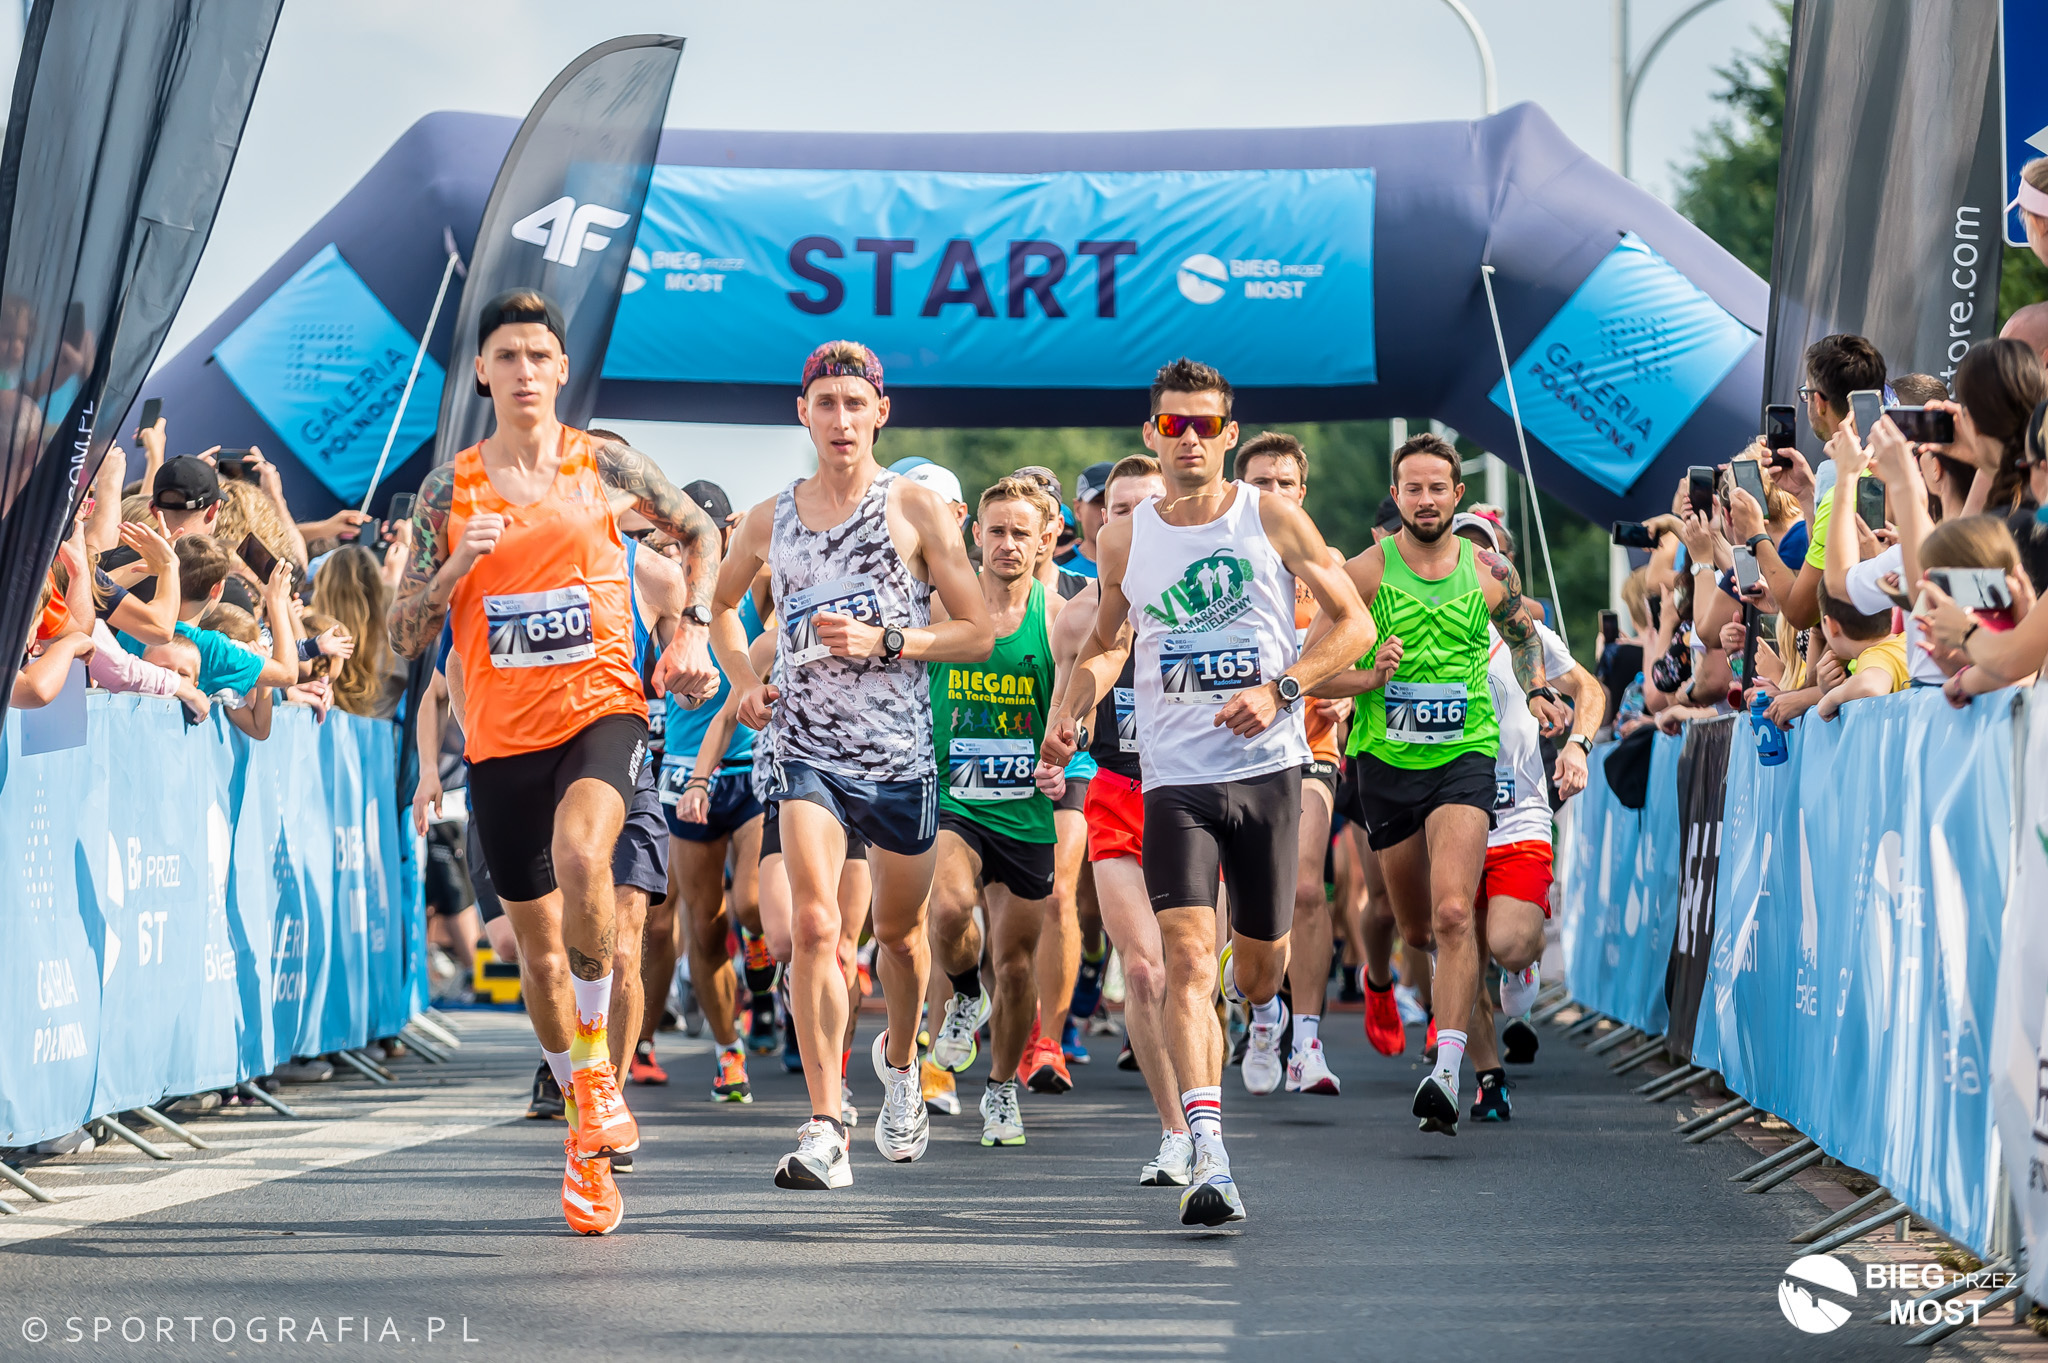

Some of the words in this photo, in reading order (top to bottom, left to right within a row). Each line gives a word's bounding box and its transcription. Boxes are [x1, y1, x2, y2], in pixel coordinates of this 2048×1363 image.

[511, 195, 631, 268] 4F
[651, 250, 702, 271] BIEG
[1229, 259, 1281, 278] BIEG
[664, 273, 726, 293] MOST
[787, 236, 1138, 319] START
[1244, 280, 1307, 299] MOST
[301, 347, 409, 446] GALERIA
[1545, 342, 1654, 443] GALERIA
[526, 606, 587, 643] 630
[1199, 650, 1255, 680] 165
[1416, 700, 1462, 724] 616
[984, 755, 1031, 779] 178
